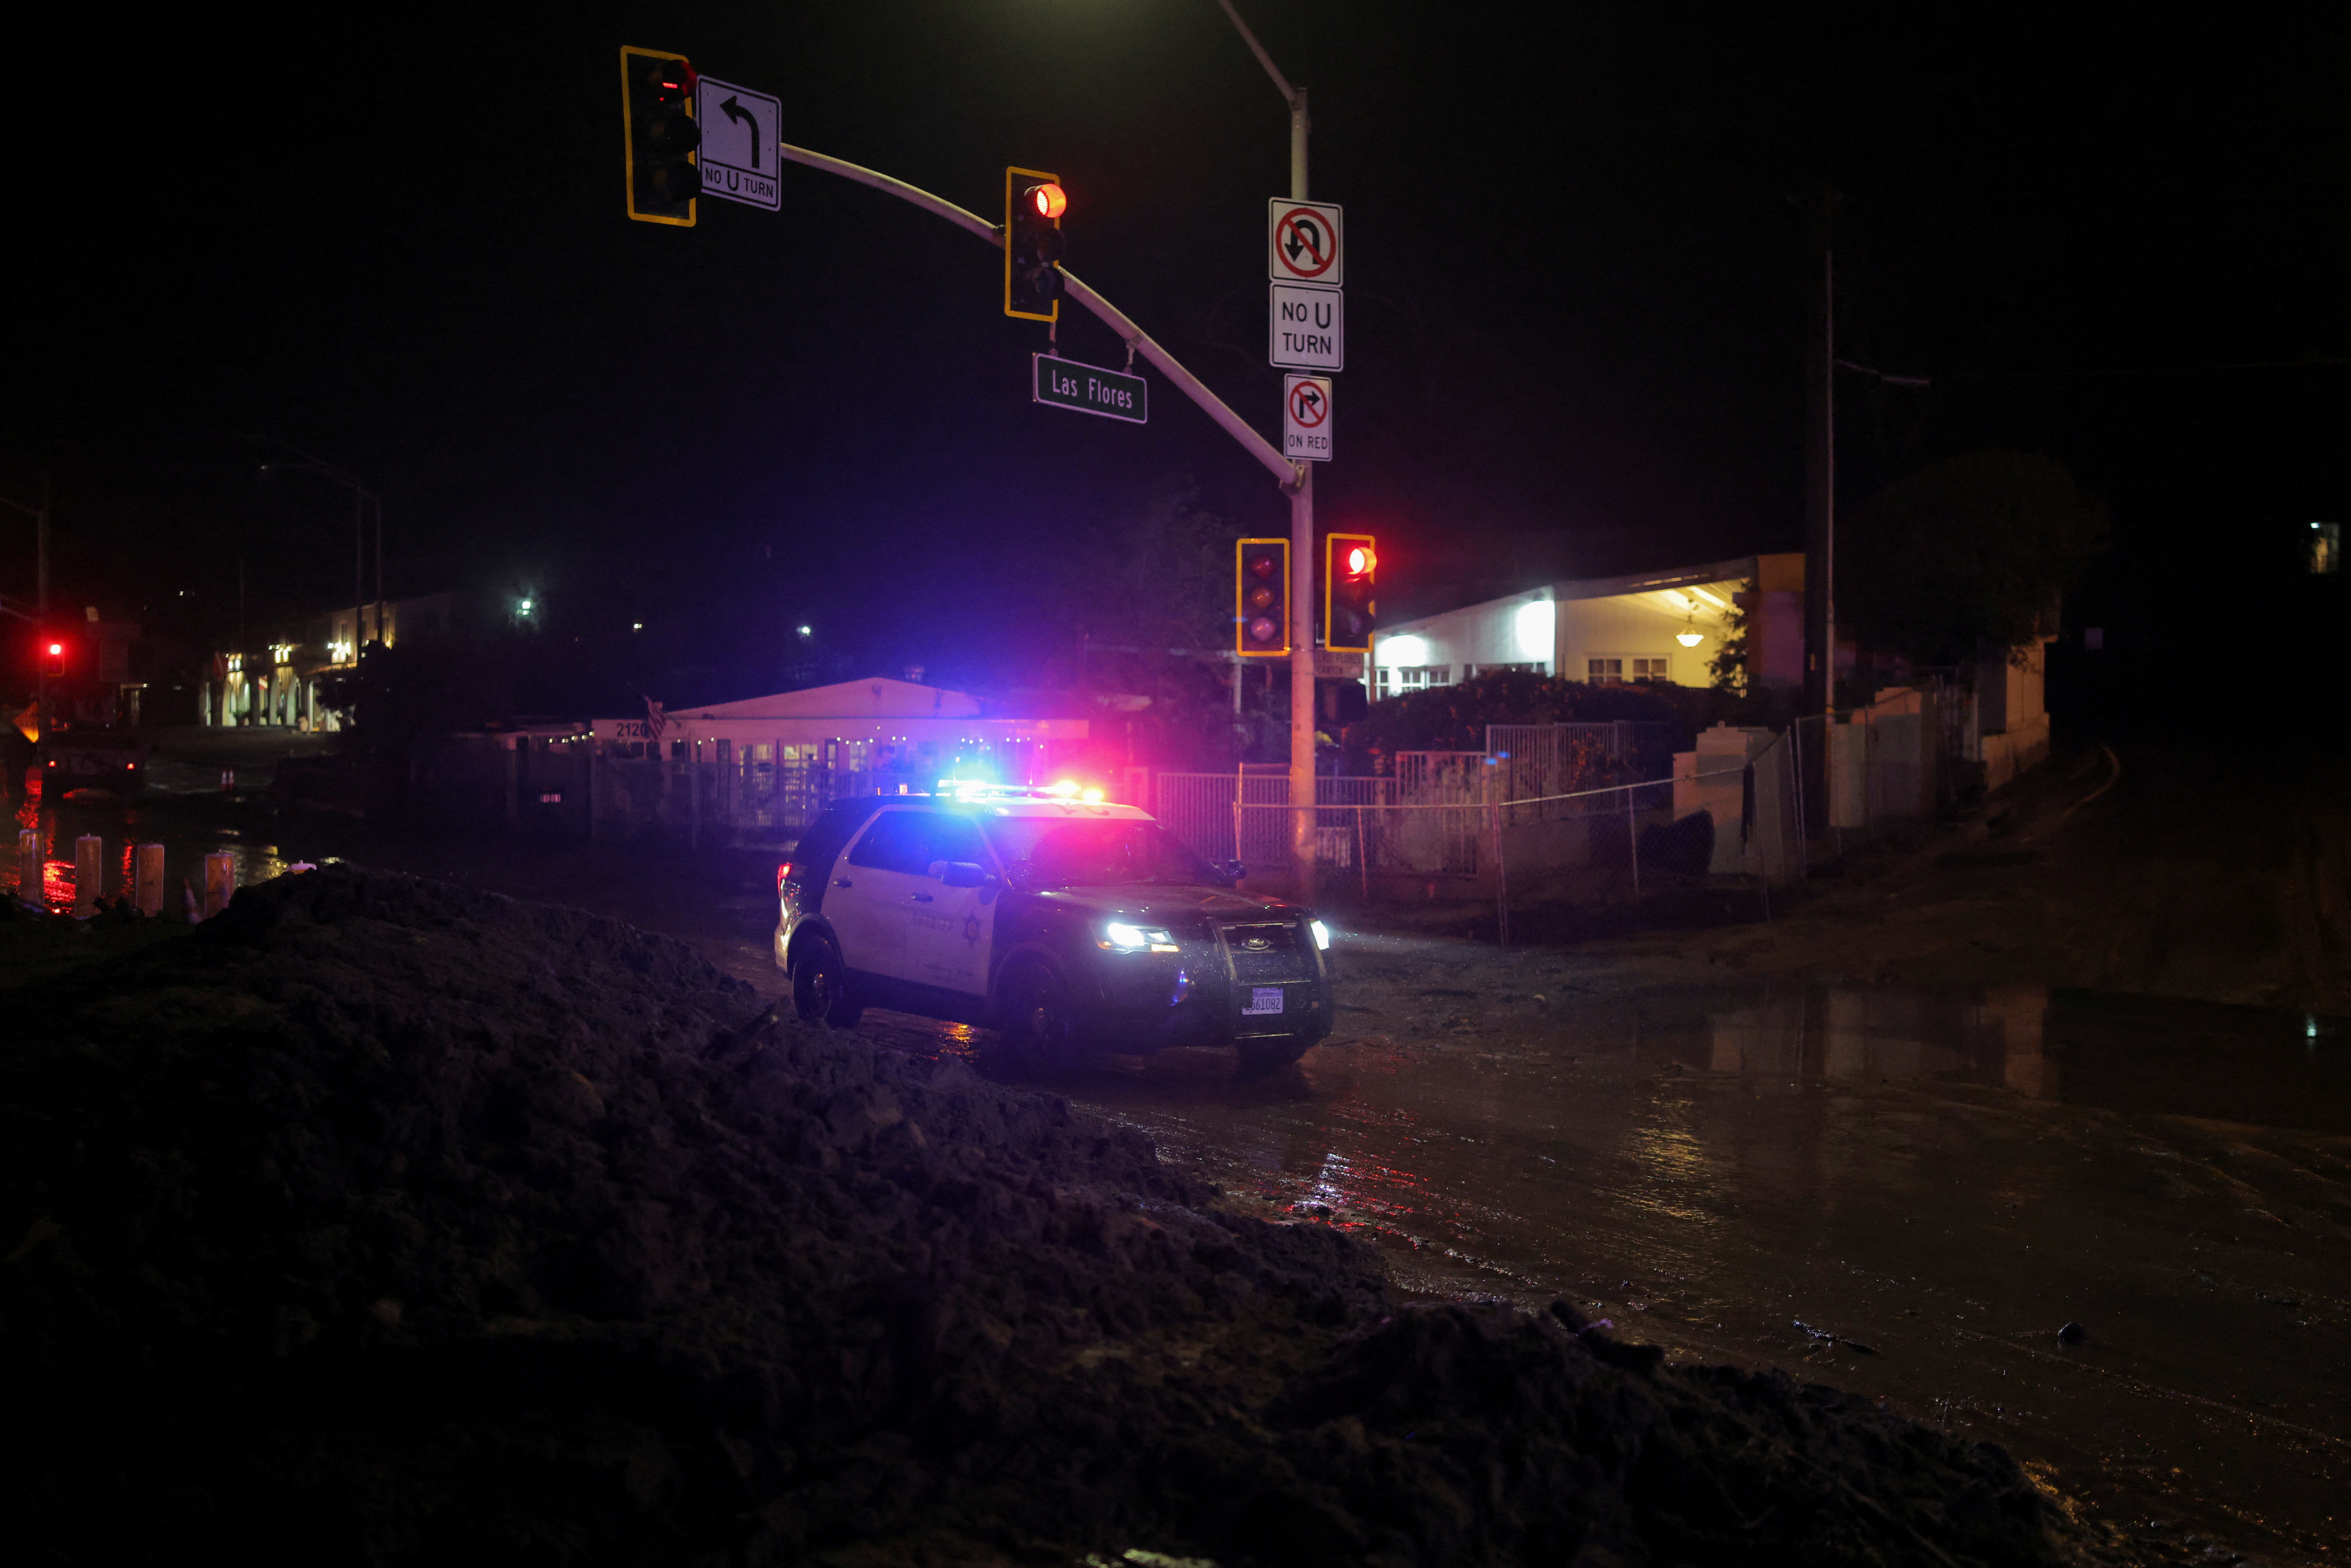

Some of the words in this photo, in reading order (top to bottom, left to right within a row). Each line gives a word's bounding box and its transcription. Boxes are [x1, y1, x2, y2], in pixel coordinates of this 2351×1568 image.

[705, 167, 721, 184] NO
[727, 170, 739, 192] U
[744, 178, 774, 197] TURN
[1282, 302, 1307, 322] NO
[1315, 302, 1331, 329] U
[1282, 333, 1331, 355] TURN
[1052, 369, 1078, 397] Las
[1089, 377, 1132, 409] Flores
[1288, 434, 1303, 448] ON
[1308, 436, 1328, 449] RED
[1246, 998, 1280, 1011] 561082
